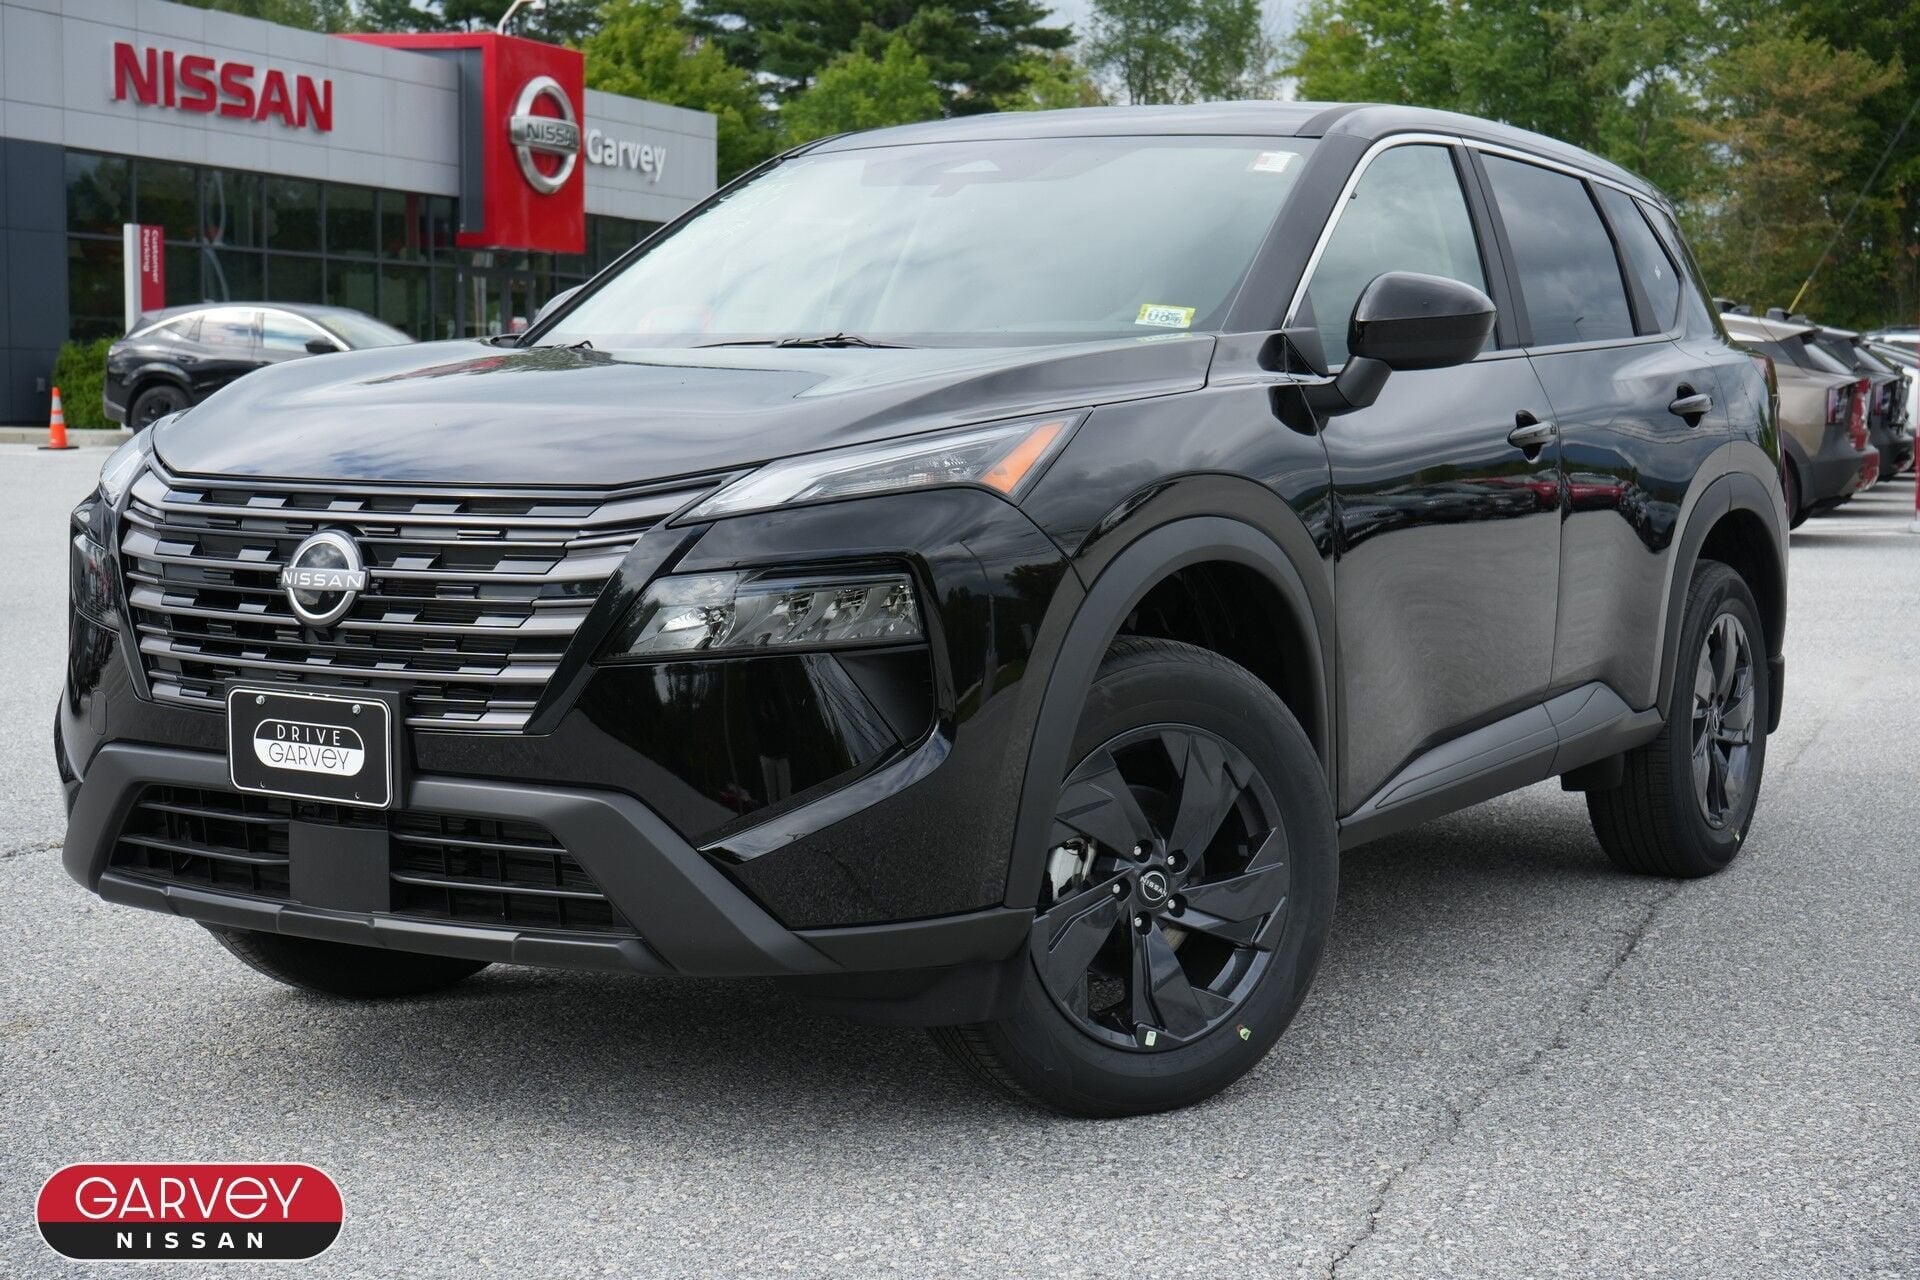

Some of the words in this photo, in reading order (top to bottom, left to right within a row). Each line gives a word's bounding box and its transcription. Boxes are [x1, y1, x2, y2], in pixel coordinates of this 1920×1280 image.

[114, 42, 332, 132] NISSAN
[587, 129, 666, 182] Garvey
[282, 571, 362, 588] NISSAN
[277, 724, 341, 746] DRIVE
[1140, 876, 1168, 897] NISSAN
